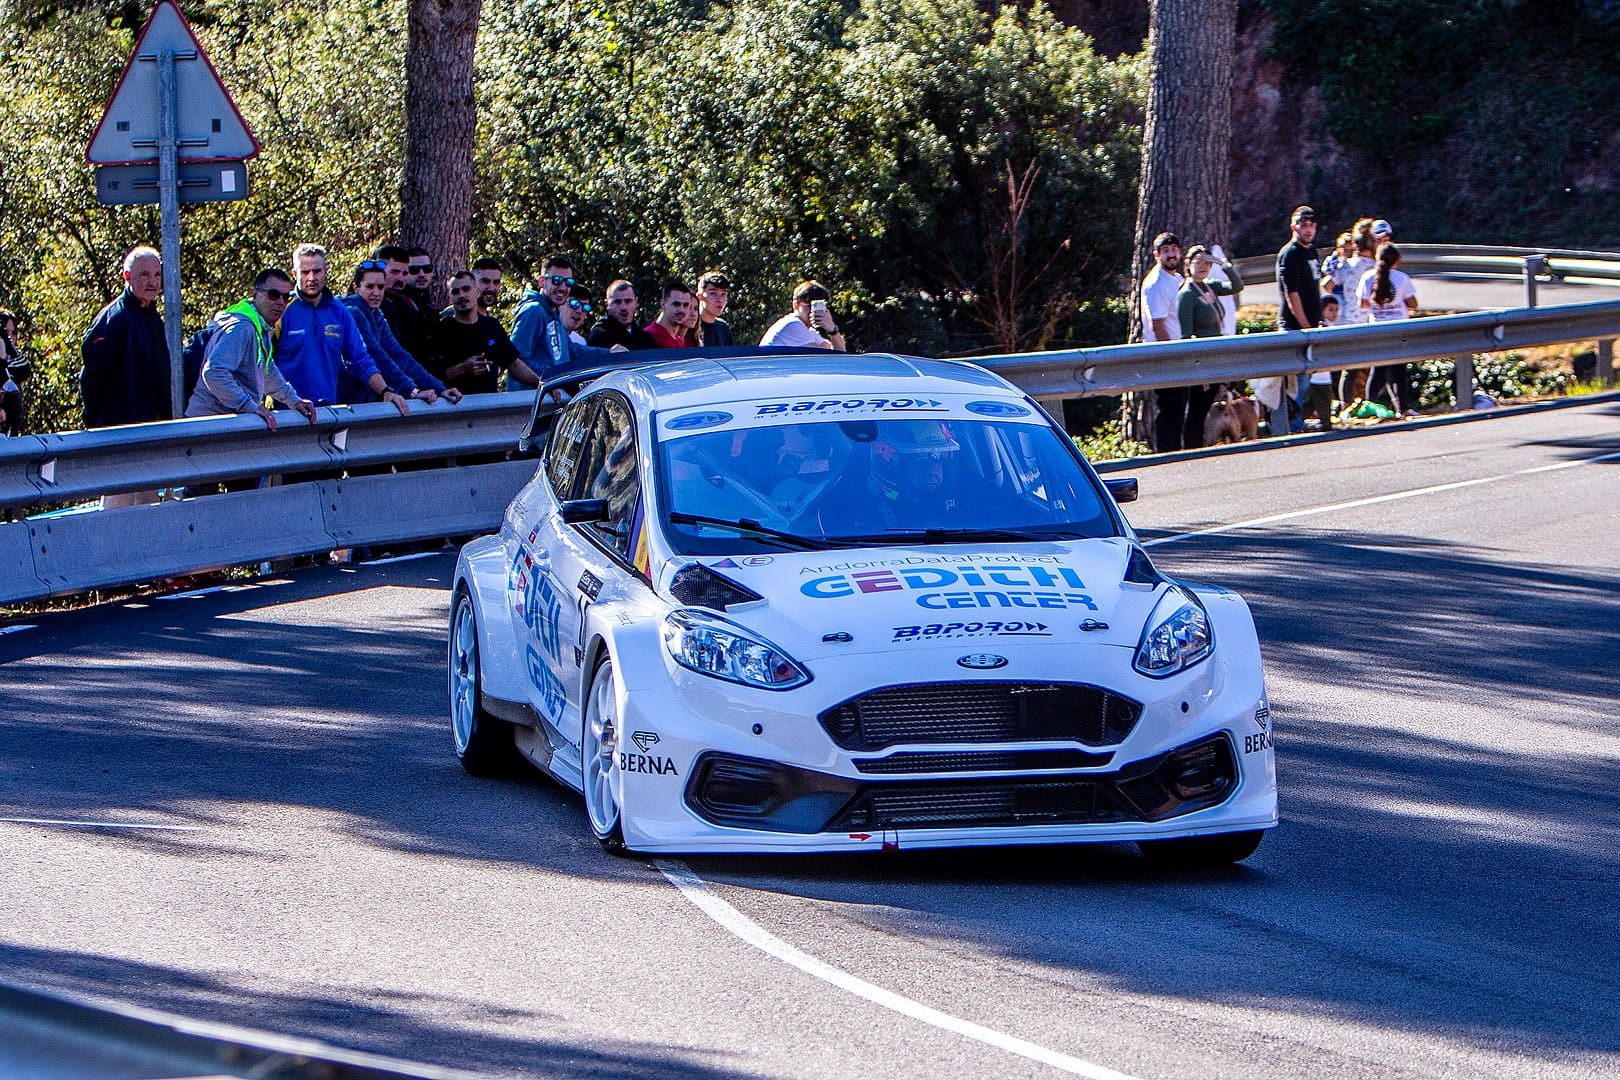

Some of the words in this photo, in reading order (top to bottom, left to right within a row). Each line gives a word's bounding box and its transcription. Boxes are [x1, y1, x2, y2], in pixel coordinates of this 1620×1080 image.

[754, 408, 878, 419] motorsport
[799, 555, 1064, 575] AndorraDataProtect
[891, 632, 994, 643] motorsport
[620, 752, 679, 776] BERNA
